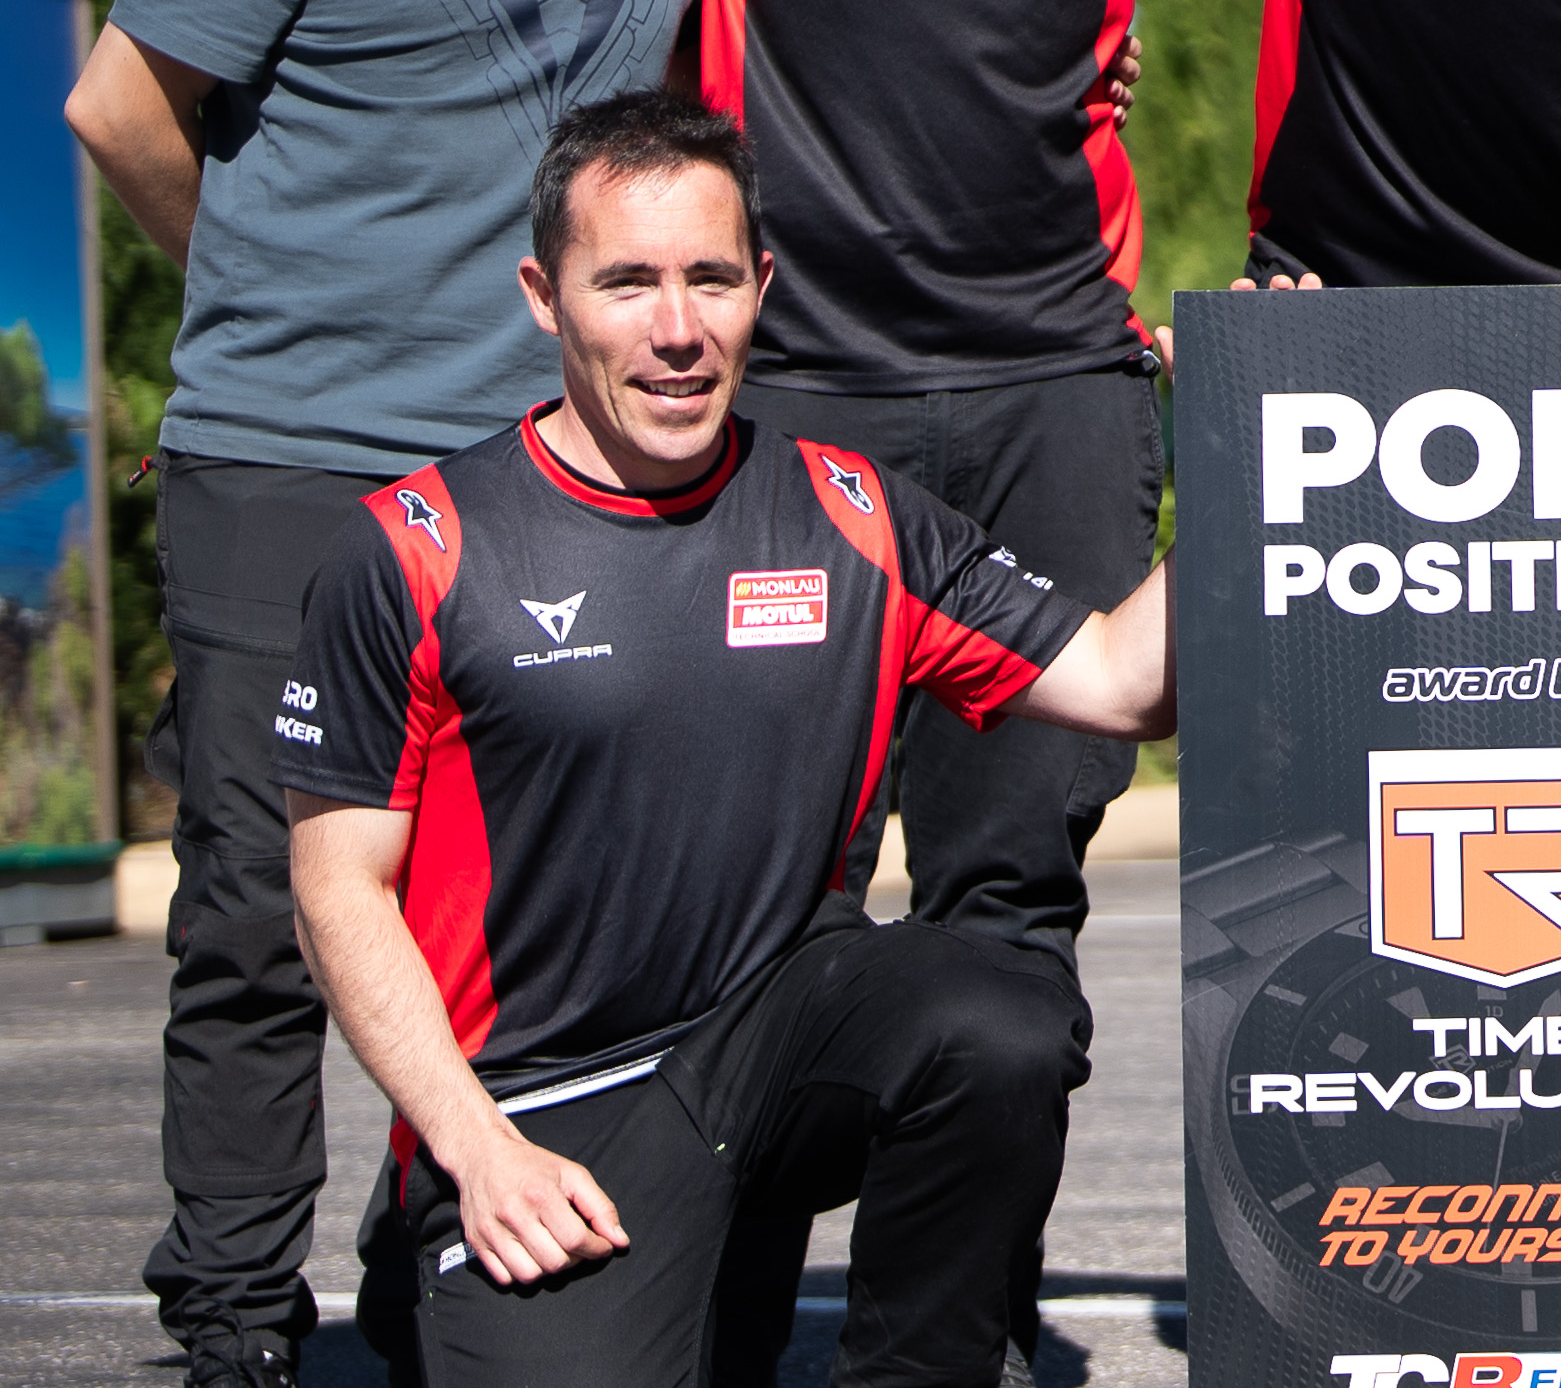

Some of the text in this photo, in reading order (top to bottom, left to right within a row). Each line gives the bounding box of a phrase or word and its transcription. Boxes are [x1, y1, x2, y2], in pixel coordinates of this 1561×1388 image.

[752, 577, 820, 597] MONLAU
[742, 603, 814, 627] MOTUL
[513, 643, 613, 668] CUPRA
[1383, 658, 1544, 702] award
[1319, 1230, 1390, 1266] TO
